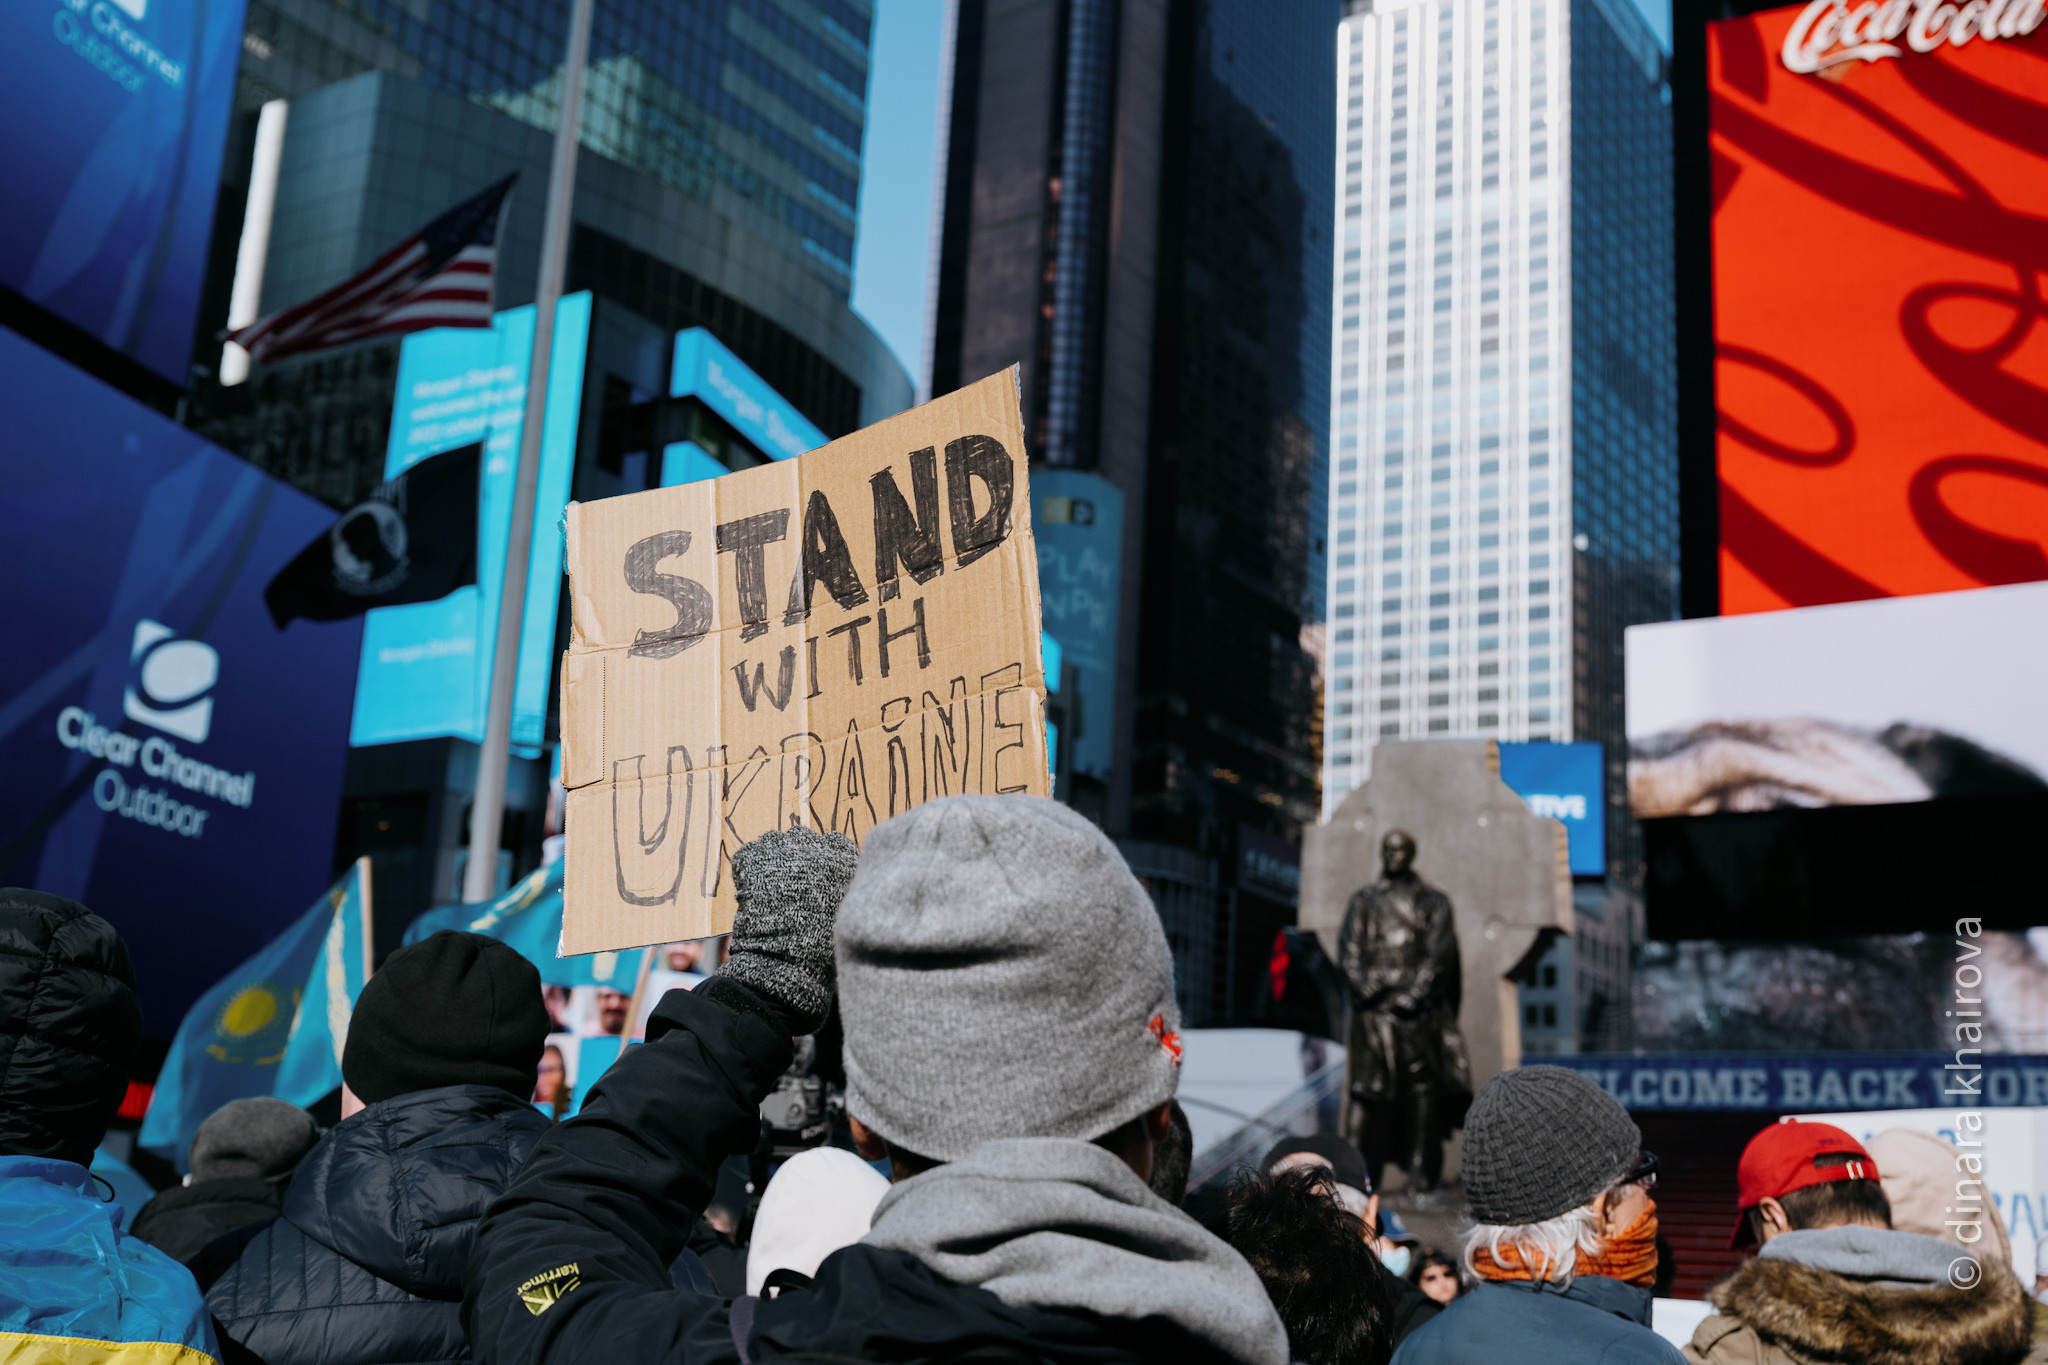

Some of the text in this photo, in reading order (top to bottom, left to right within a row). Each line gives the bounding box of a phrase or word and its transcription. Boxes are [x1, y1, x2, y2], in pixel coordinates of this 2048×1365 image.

[1781, 0, 2048, 73] Coca-Cola
[624, 435, 1014, 660] STAND
[731, 597, 931, 712] WITH
[57, 706, 256, 808] Clear Channel
[94, 769, 210, 838] Outdoor
[1524, 793, 1586, 819] TIVE
[1580, 1068, 1768, 1107] LCOME
[1782, 1068, 1918, 1108] BACK
[517, 1262, 580, 1296] karrimor
